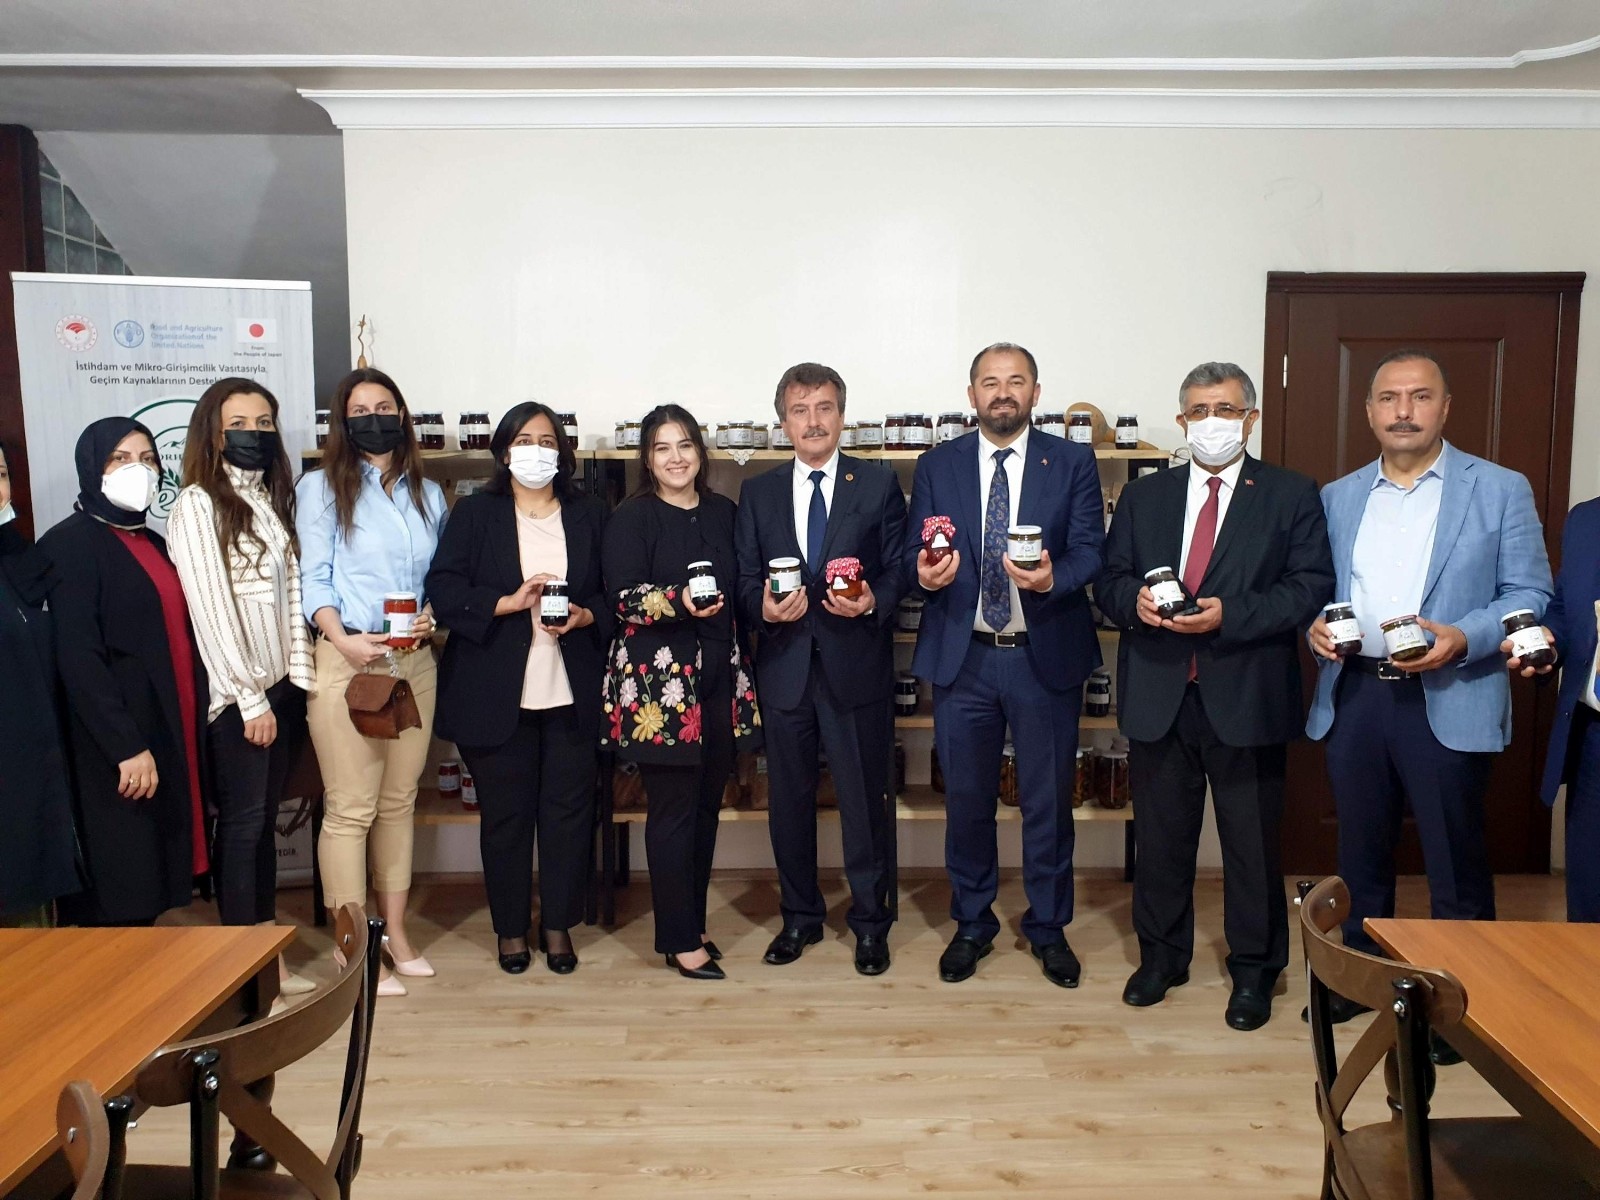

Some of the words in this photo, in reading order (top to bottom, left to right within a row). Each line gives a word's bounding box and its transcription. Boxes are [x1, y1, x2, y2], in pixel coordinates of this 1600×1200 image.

[185, 324, 224, 333] Agriculture
[206, 333, 218, 341] the
[176, 341, 205, 350] Nations
[76, 360, 118, 371] İstihdam
[135, 363, 216, 374] Mikro-Girişimcilik
[90, 376, 120, 386] Geçim
[123, 376, 187, 386] Kaynaklarının
